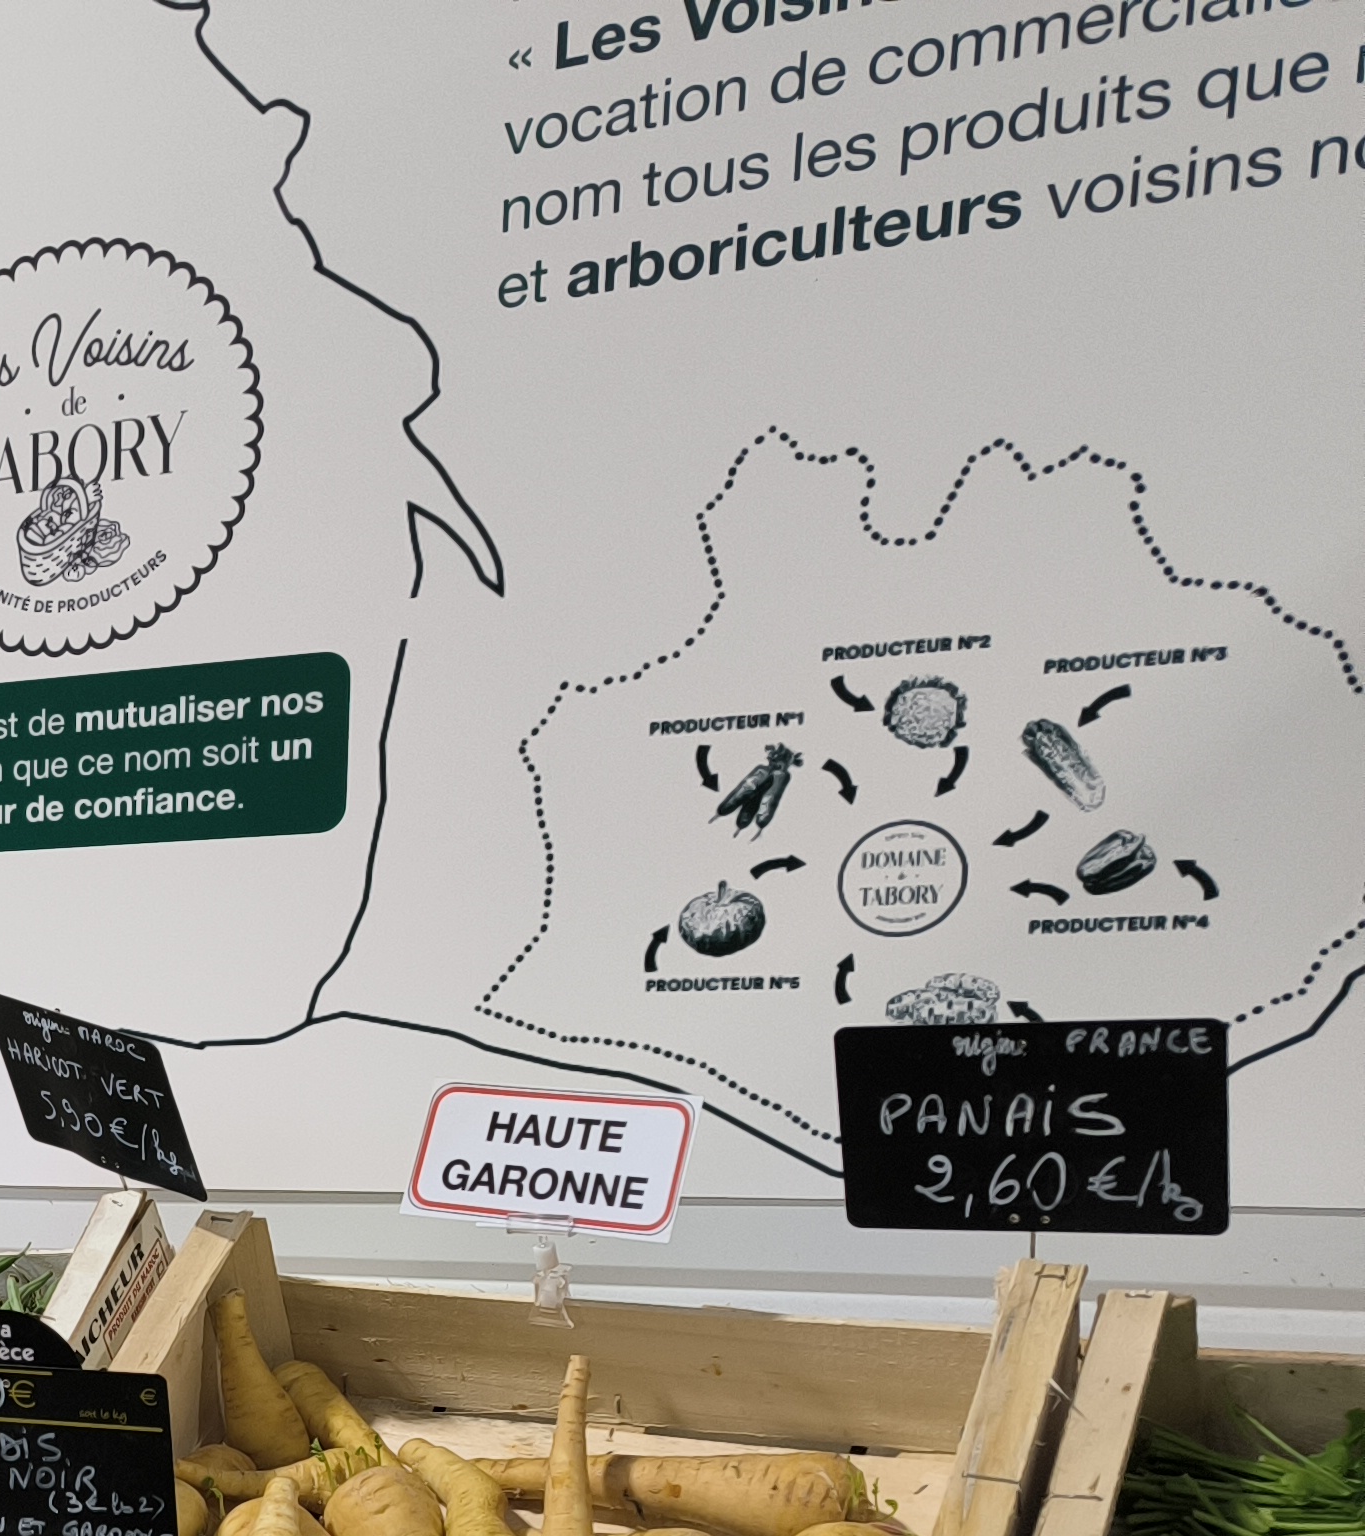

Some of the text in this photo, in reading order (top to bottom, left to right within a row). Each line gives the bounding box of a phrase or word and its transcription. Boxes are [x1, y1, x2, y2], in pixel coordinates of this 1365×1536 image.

[555, 15, 662, 70] Les
[505, 49, 846, 155] vocation de
[502, 51, 1329, 233] nom tous les produits que
[498, 145, 1280, 309] et arboriculteurs voisins
[31, 307, 195, 387] Voisins
[61, 385, 88, 417] de
[34, 599, 54, 614] DE
[56, 549, 168, 614] PRODUCTEURS
[822, 637, 952, 662] PRODUCTEUR
[1044, 648, 1185, 675] PRODUCTEUR
[28, 708, 65, 737] de
[76, 695, 250, 733] mutualiser
[261, 691, 323, 718] nos
[650, 713, 770, 736] PRODUCTEUR
[13, 756, 68, 787] que
[78, 753, 113, 776] ce
[125, 747, 190, 773] nom
[203, 735, 259, 767] soit
[271, 737, 312, 762] un
[26, 795, 64, 823] de
[75, 786, 243, 820] confiance.
[860, 848, 947, 870] DOMAINE
[859, 883, 944, 907] TABORY
[1028, 915, 1167, 934] PRODUCTEUR
[645, 976, 764, 992] PRODUCTEUR
[1066, 1026, 1212, 1057] FRANCE
[100, 1073, 164, 1109] VERT
[40, 1090, 103, 1138] 5,90
[485, 1110, 628, 1154] HAUTE
[441, 1158, 649, 1210] GARONNE
[914, 1150, 1067, 1218] 2,60
[18, 1517, 46, 1536] ET
